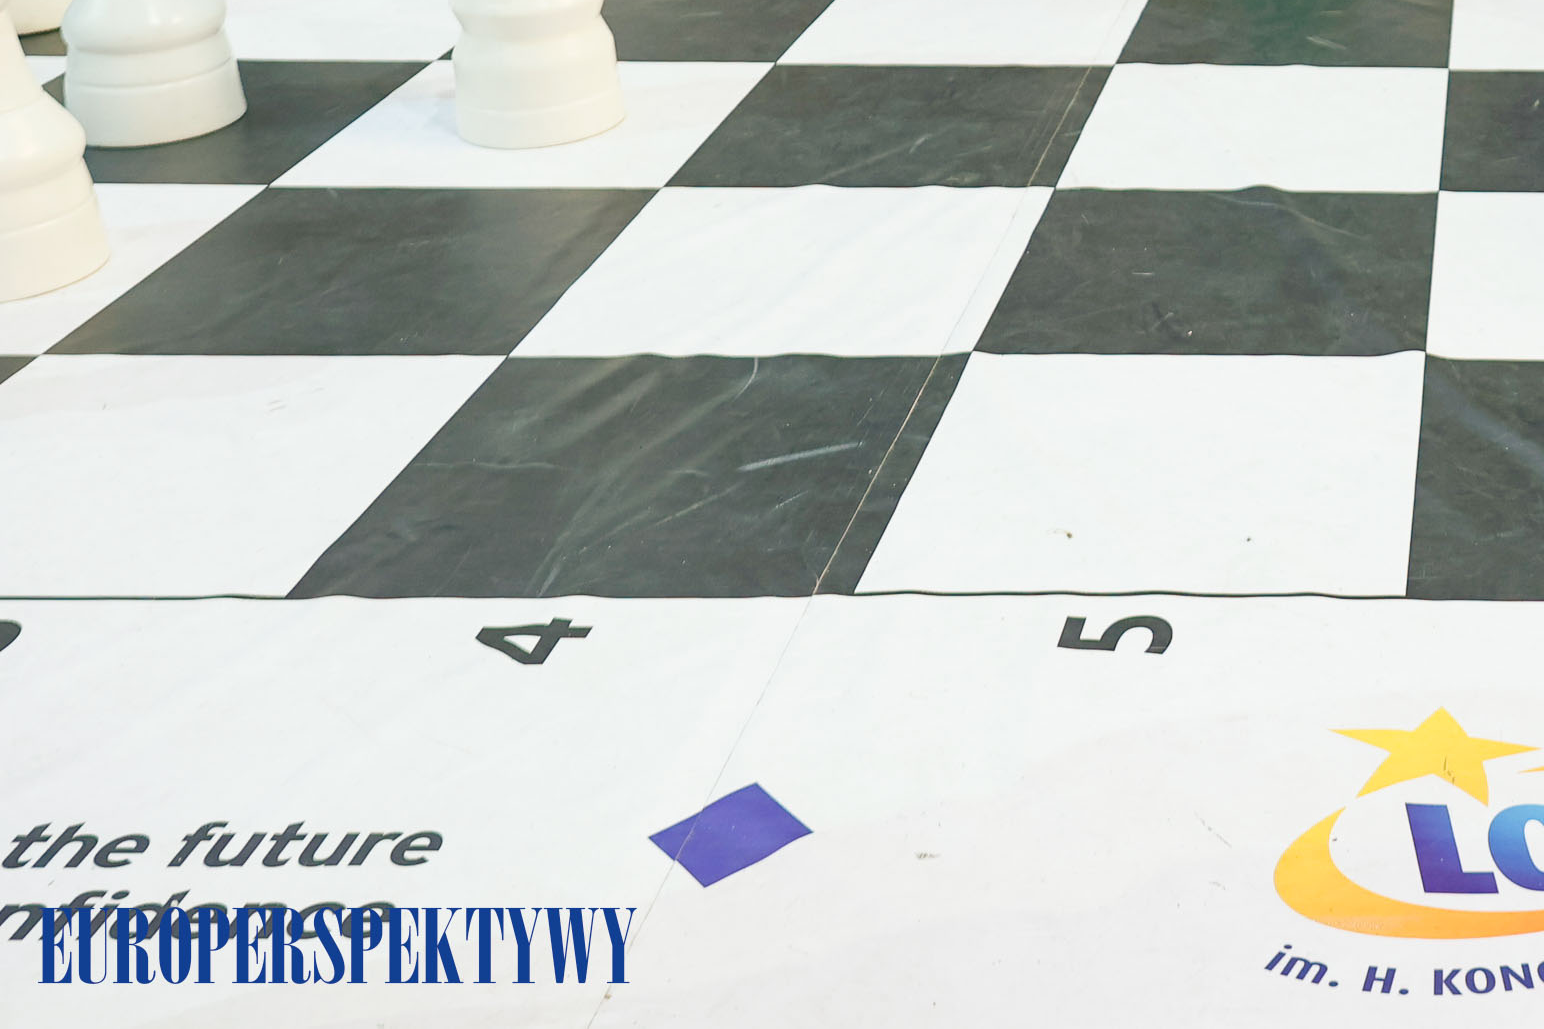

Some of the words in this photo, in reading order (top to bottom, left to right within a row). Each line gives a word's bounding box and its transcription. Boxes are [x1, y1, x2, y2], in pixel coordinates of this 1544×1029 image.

[475, 618, 593, 665] 4
[1057, 616, 1173, 654] 5
[2, 823, 151, 869] the
[167, 822, 444, 868] future
[1264, 944, 1339, 988] im.
[1361, 965, 1409, 996] H.
